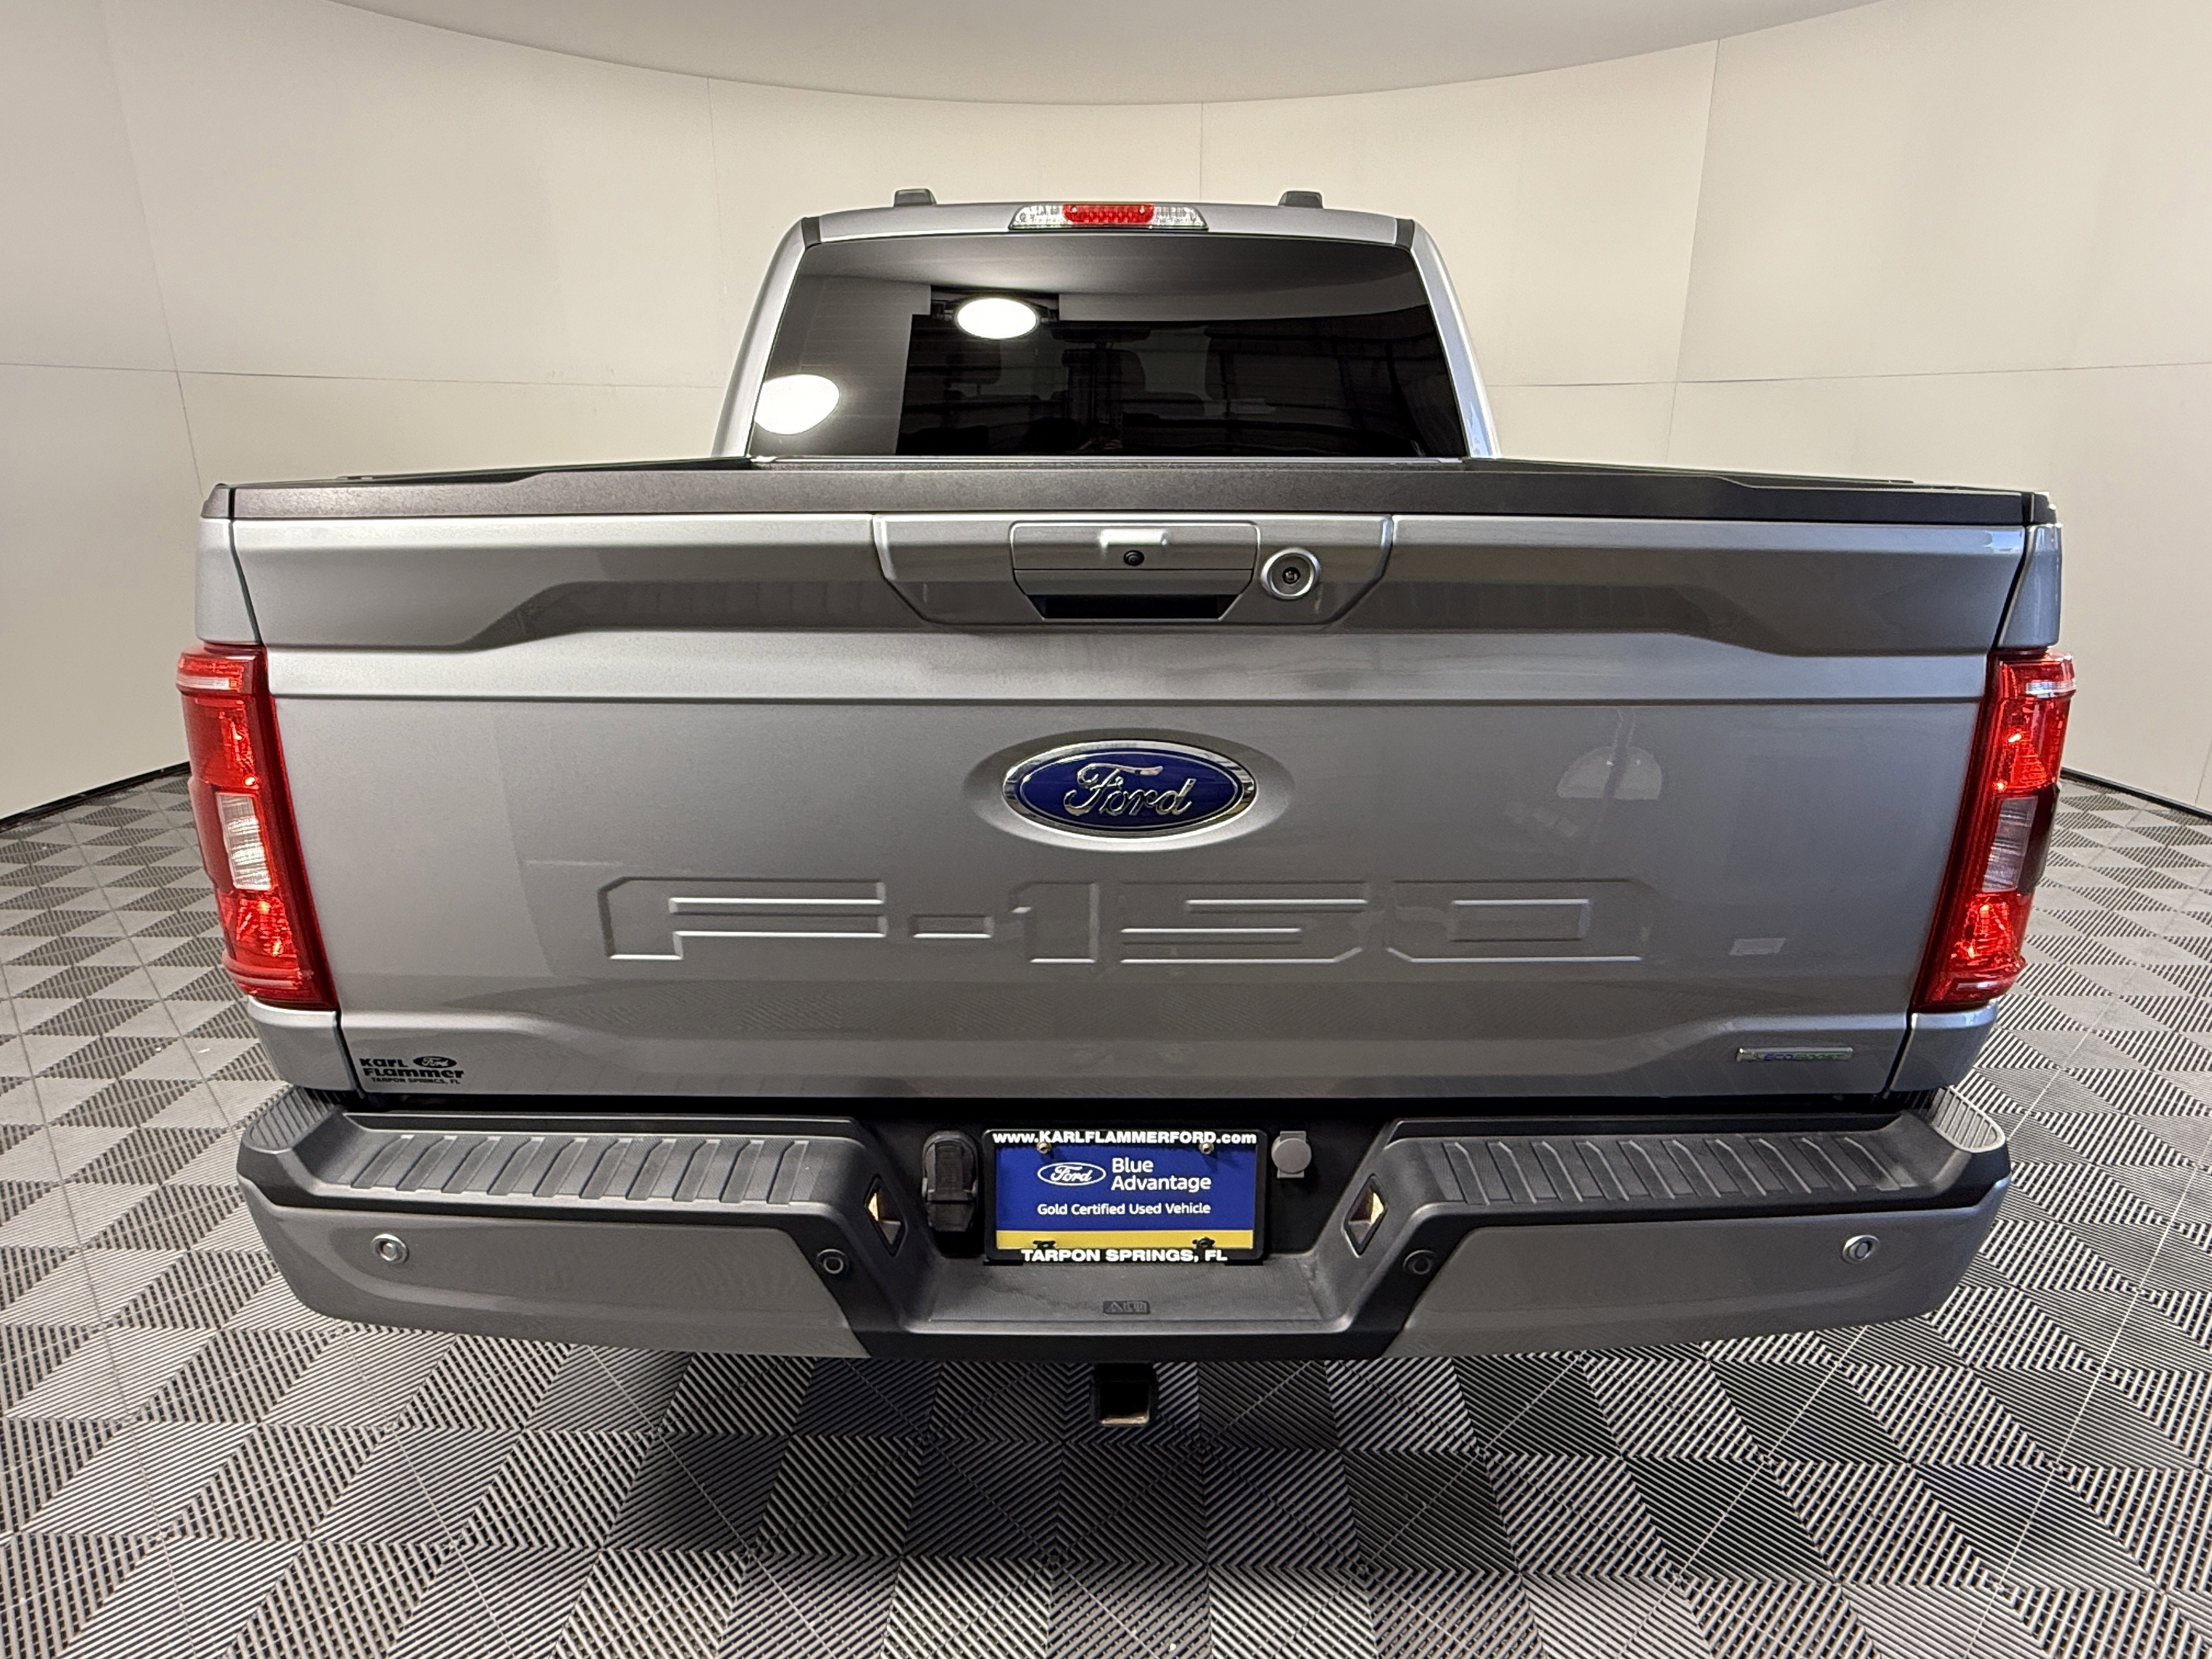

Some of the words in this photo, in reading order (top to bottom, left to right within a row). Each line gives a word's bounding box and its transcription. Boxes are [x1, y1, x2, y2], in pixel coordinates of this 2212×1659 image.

[1063, 762, 1197, 816] Ford
[597, 875, 1654, 964] F-150
[421, 1057, 449, 1067] Ford
[992, 1131, 1257, 1144] www.KARLFLAMMERFORD.com
[1111, 1157, 1154, 1173] Blue
[1050, 1165, 1092, 1182] Ford
[1111, 1176, 1212, 1193] Advantage
[1037, 1203, 1068, 1216] Gold
[1071, 1203, 1126, 1215] Certified
[1129, 1203, 1163, 1215] Used
[1165, 1202, 1211, 1215] Vehicle
[1020, 1249, 1101, 1262] TARPON
[1105, 1249, 1199, 1263] SPRINGS,
[1205, 1249, 1228, 1262] FL
